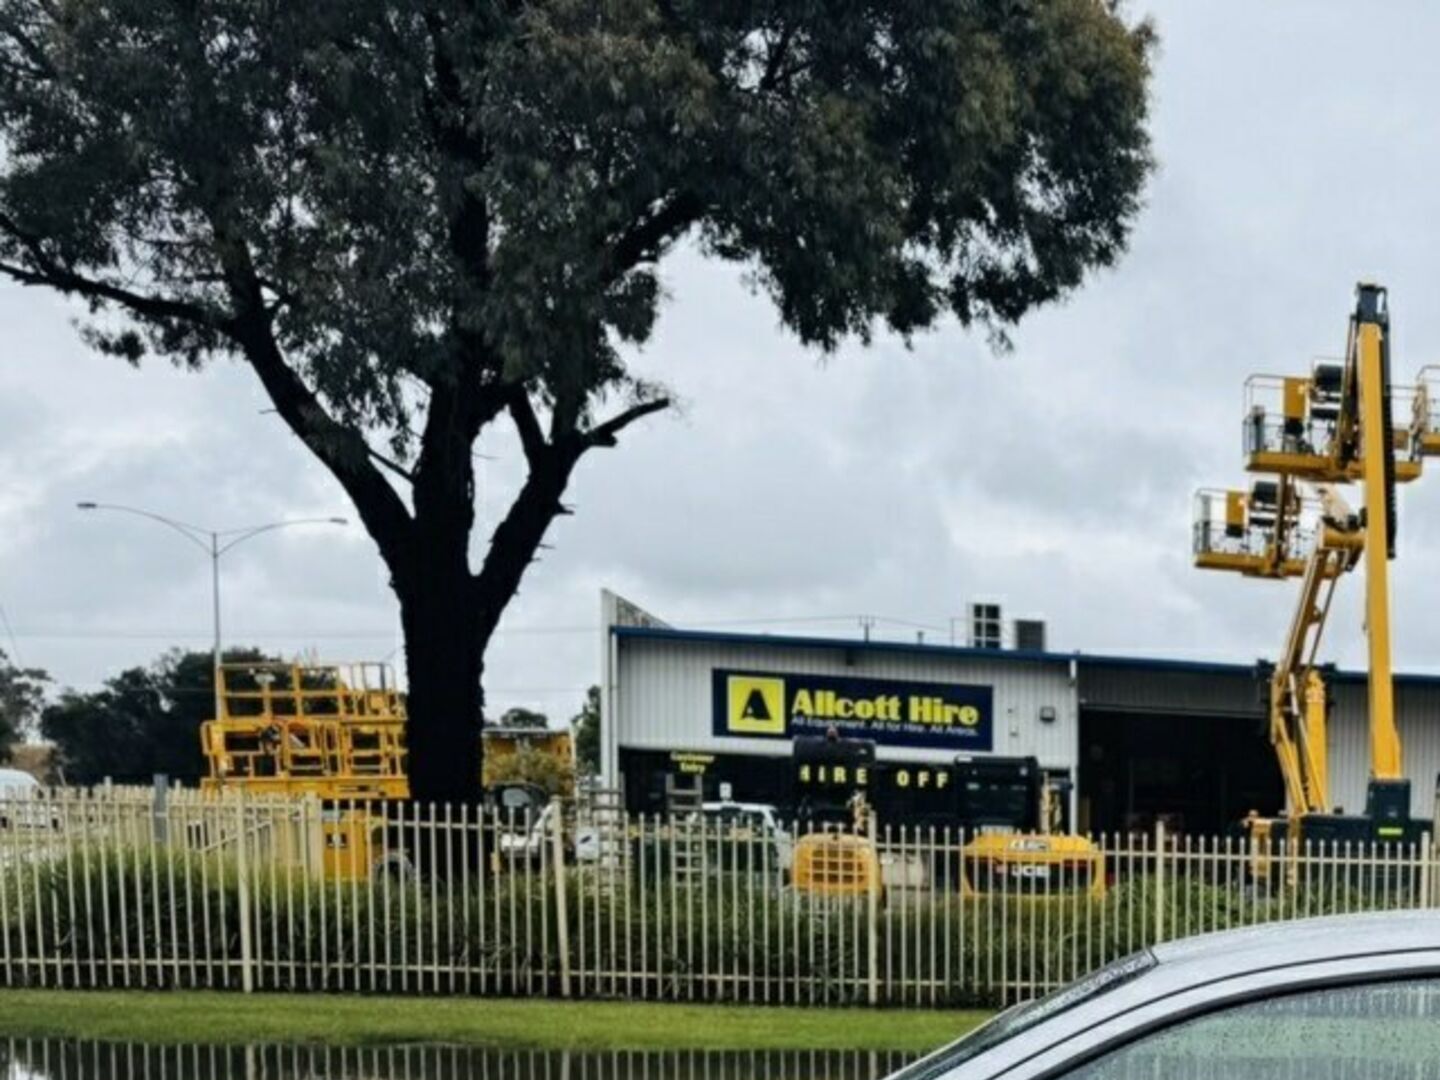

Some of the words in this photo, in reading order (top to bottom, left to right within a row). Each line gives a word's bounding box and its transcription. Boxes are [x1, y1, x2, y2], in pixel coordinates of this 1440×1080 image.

[741, 689, 772, 720] A
[791, 688, 901, 721] Allcott
[908, 695, 979, 725] Hire
[799, 764, 867, 785] HIRE
